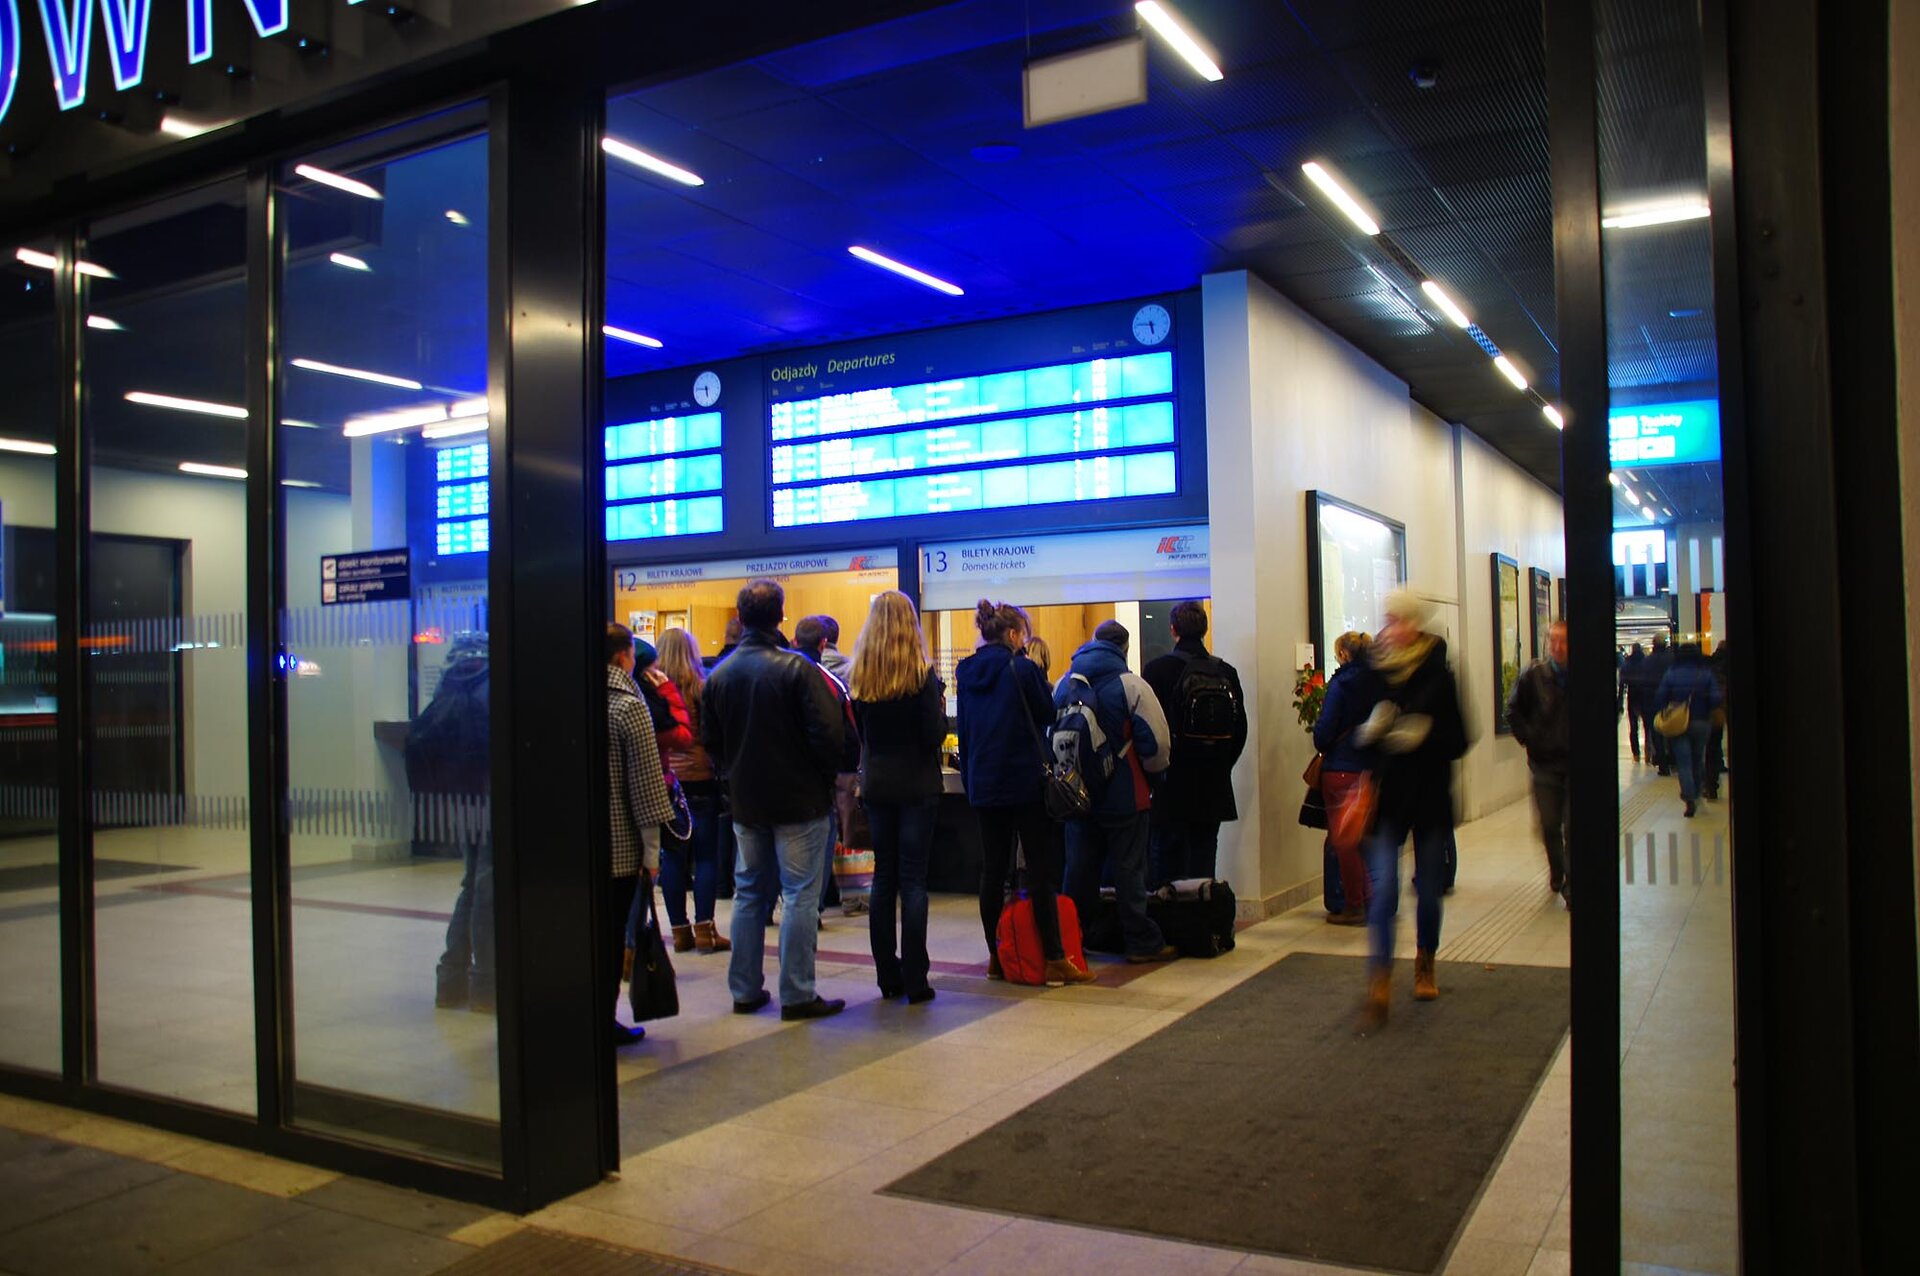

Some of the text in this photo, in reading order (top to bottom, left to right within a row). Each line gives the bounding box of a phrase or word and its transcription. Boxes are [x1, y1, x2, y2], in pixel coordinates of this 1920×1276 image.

[771, 353, 896, 382] Odjazdy Departures
[961, 545, 1036, 558] BILETY KRAJOWE
[746, 558, 829, 573] PRZEJAZDY GRUPOWE
[923, 550, 948, 573] 13
[962, 560, 1026, 572] Domestic tickets
[670, 567, 703, 577] KRAJOWE
[619, 571, 638, 592] 12
